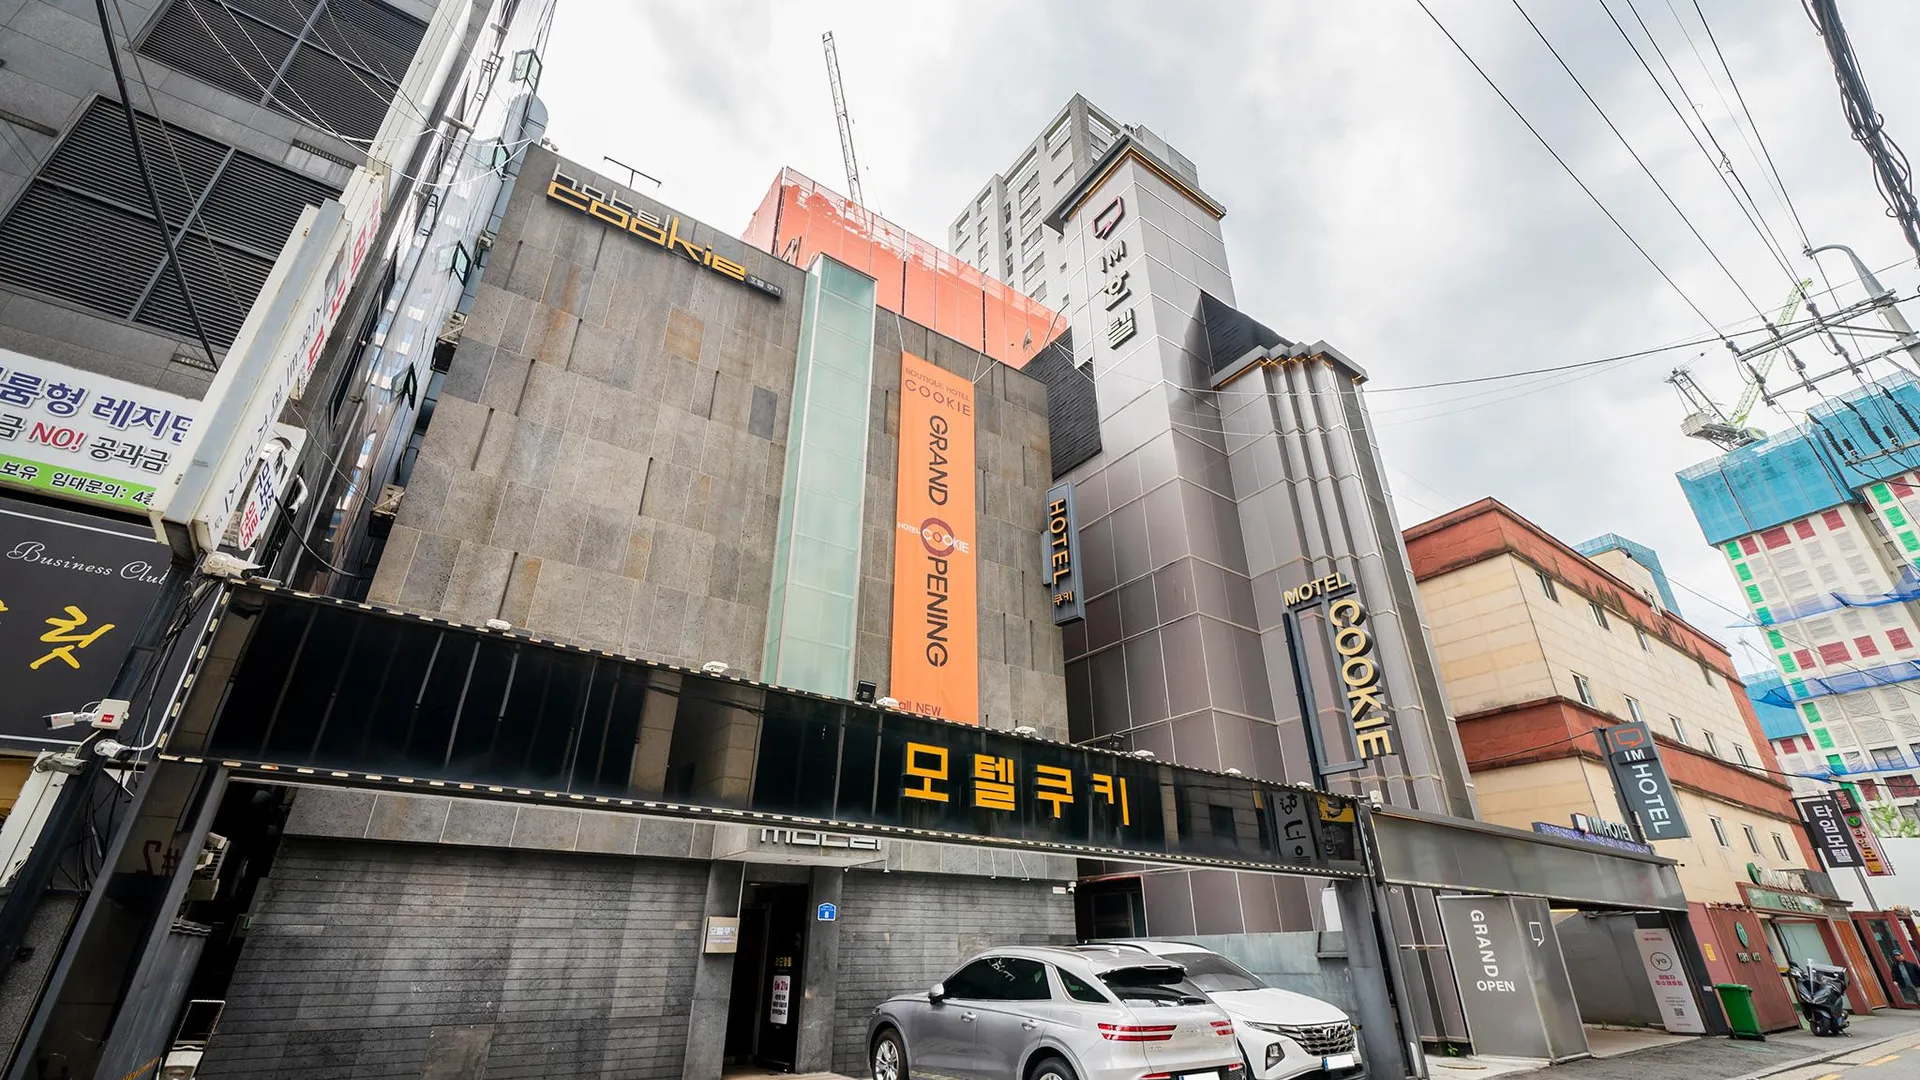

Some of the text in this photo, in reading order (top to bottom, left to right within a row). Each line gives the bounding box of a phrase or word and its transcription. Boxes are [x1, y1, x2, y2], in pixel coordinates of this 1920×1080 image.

[552, 163, 671, 231] hotel
[546, 180, 746, 282] cookie
[0, 366, 86, 416] 룸형
[905, 367, 971, 402] BOUTIQUE HOTEL
[905, 379, 971, 417] COOKIE
[28, 420, 86, 451] NO!
[90, 436, 170, 472] 공과금
[928, 414, 949, 506] GRAND
[1, 461, 39, 480] 보유
[51, 472, 127, 499] 임대문의:
[6, 541, 113, 576] Business
[897, 521, 970, 554] HOTEL COOKIE
[1049, 498, 1070, 586] HOTEL
[1053, 590, 1074, 606] 쿠키
[1283, 572, 1351, 607] MOTEL
[1328, 598, 1394, 760] COOKIE
[915, 702, 942, 718] NEW
[1624, 748, 1646, 762] IM
[903, 741, 1131, 827] 모텔쿠키
[1631, 763, 1672, 834] HOTEL
[1812, 804, 1854, 863] 타임모텔
[824, 910, 830, 919] 8
[1470, 909, 1499, 978] GRAND
[1476, 980, 1516, 992] OPEN
